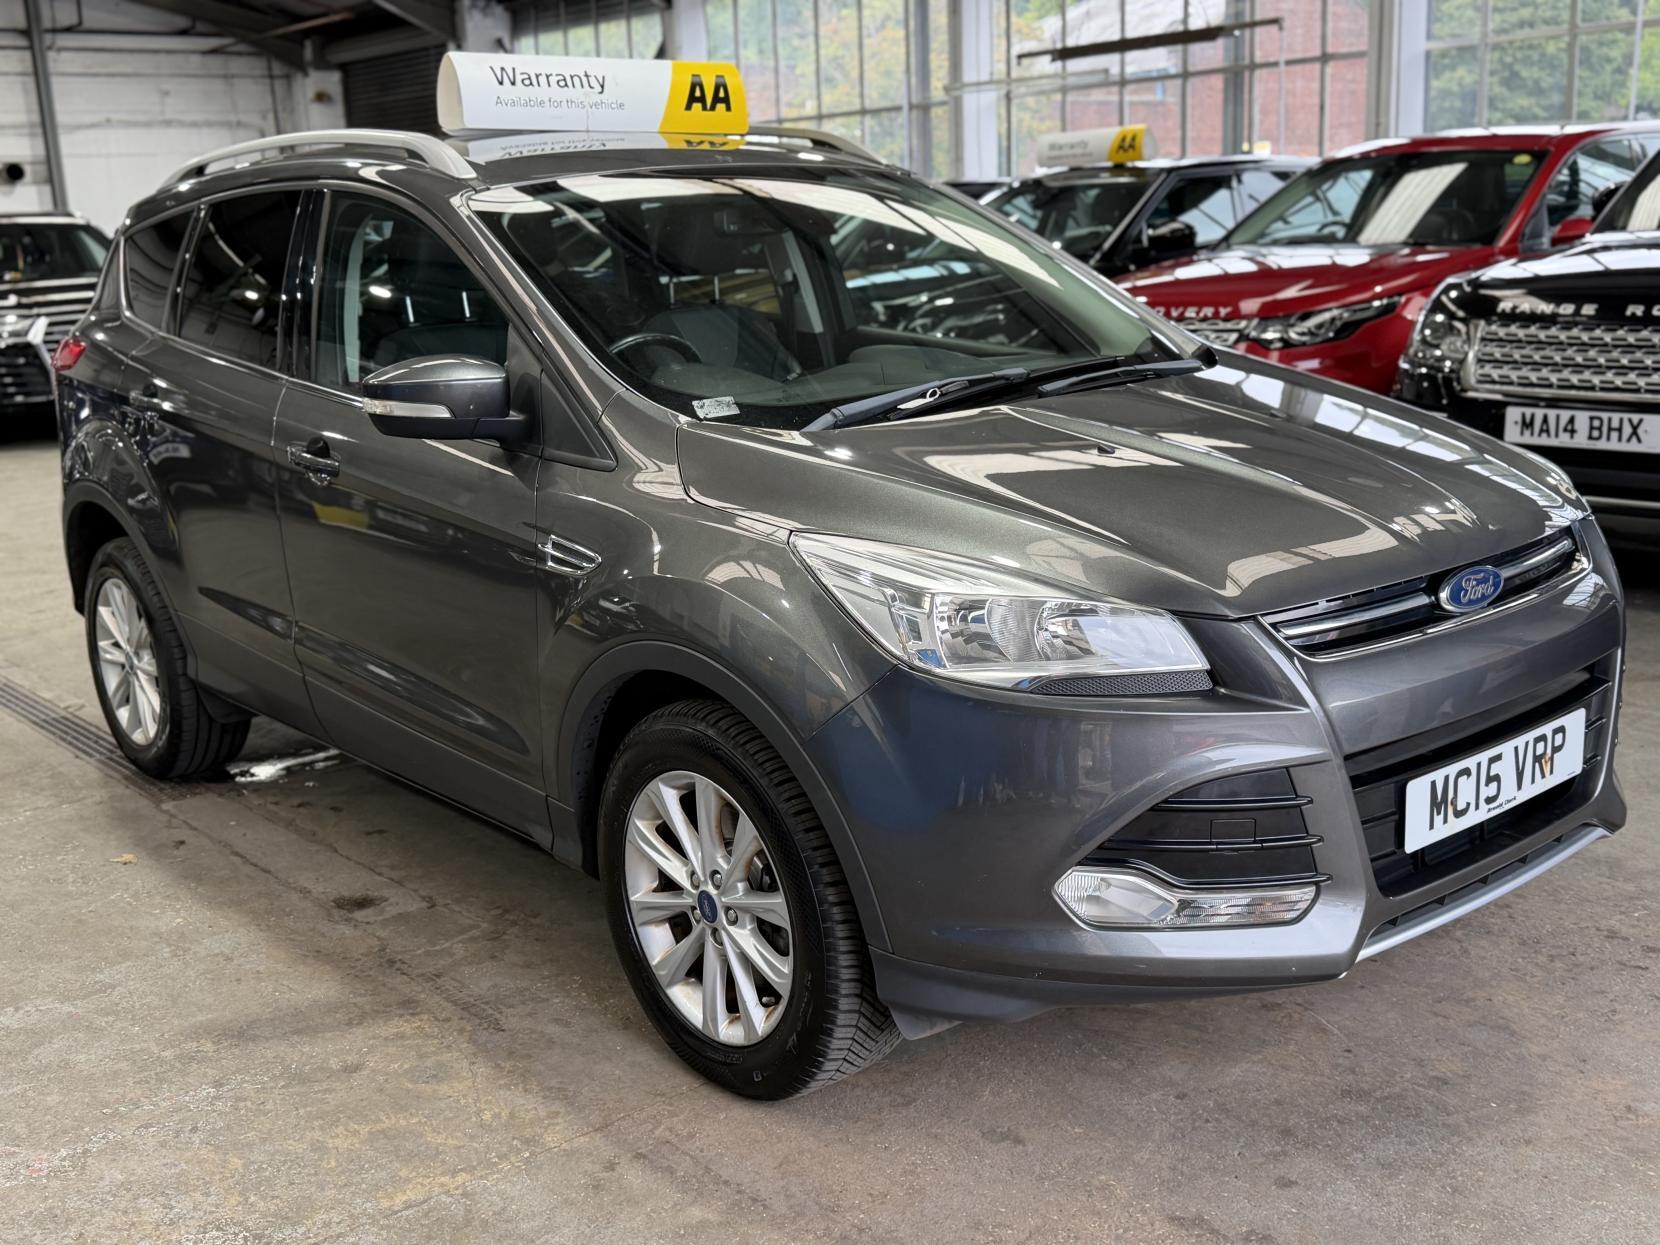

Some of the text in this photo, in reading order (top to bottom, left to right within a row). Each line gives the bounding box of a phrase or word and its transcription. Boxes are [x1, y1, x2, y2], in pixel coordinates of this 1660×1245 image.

[489, 65, 606, 95] Warranty
[684, 74, 732, 112] AA
[495, 95, 626, 111] Available for this vehicle
[1116, 133, 1138, 153] AA
[1496, 302, 1600, 316] RANGE
[1519, 411, 1645, 445] MA14 BHX
[1460, 572, 1495, 603] Ford
[1428, 723, 1567, 832] MC15 VRP
